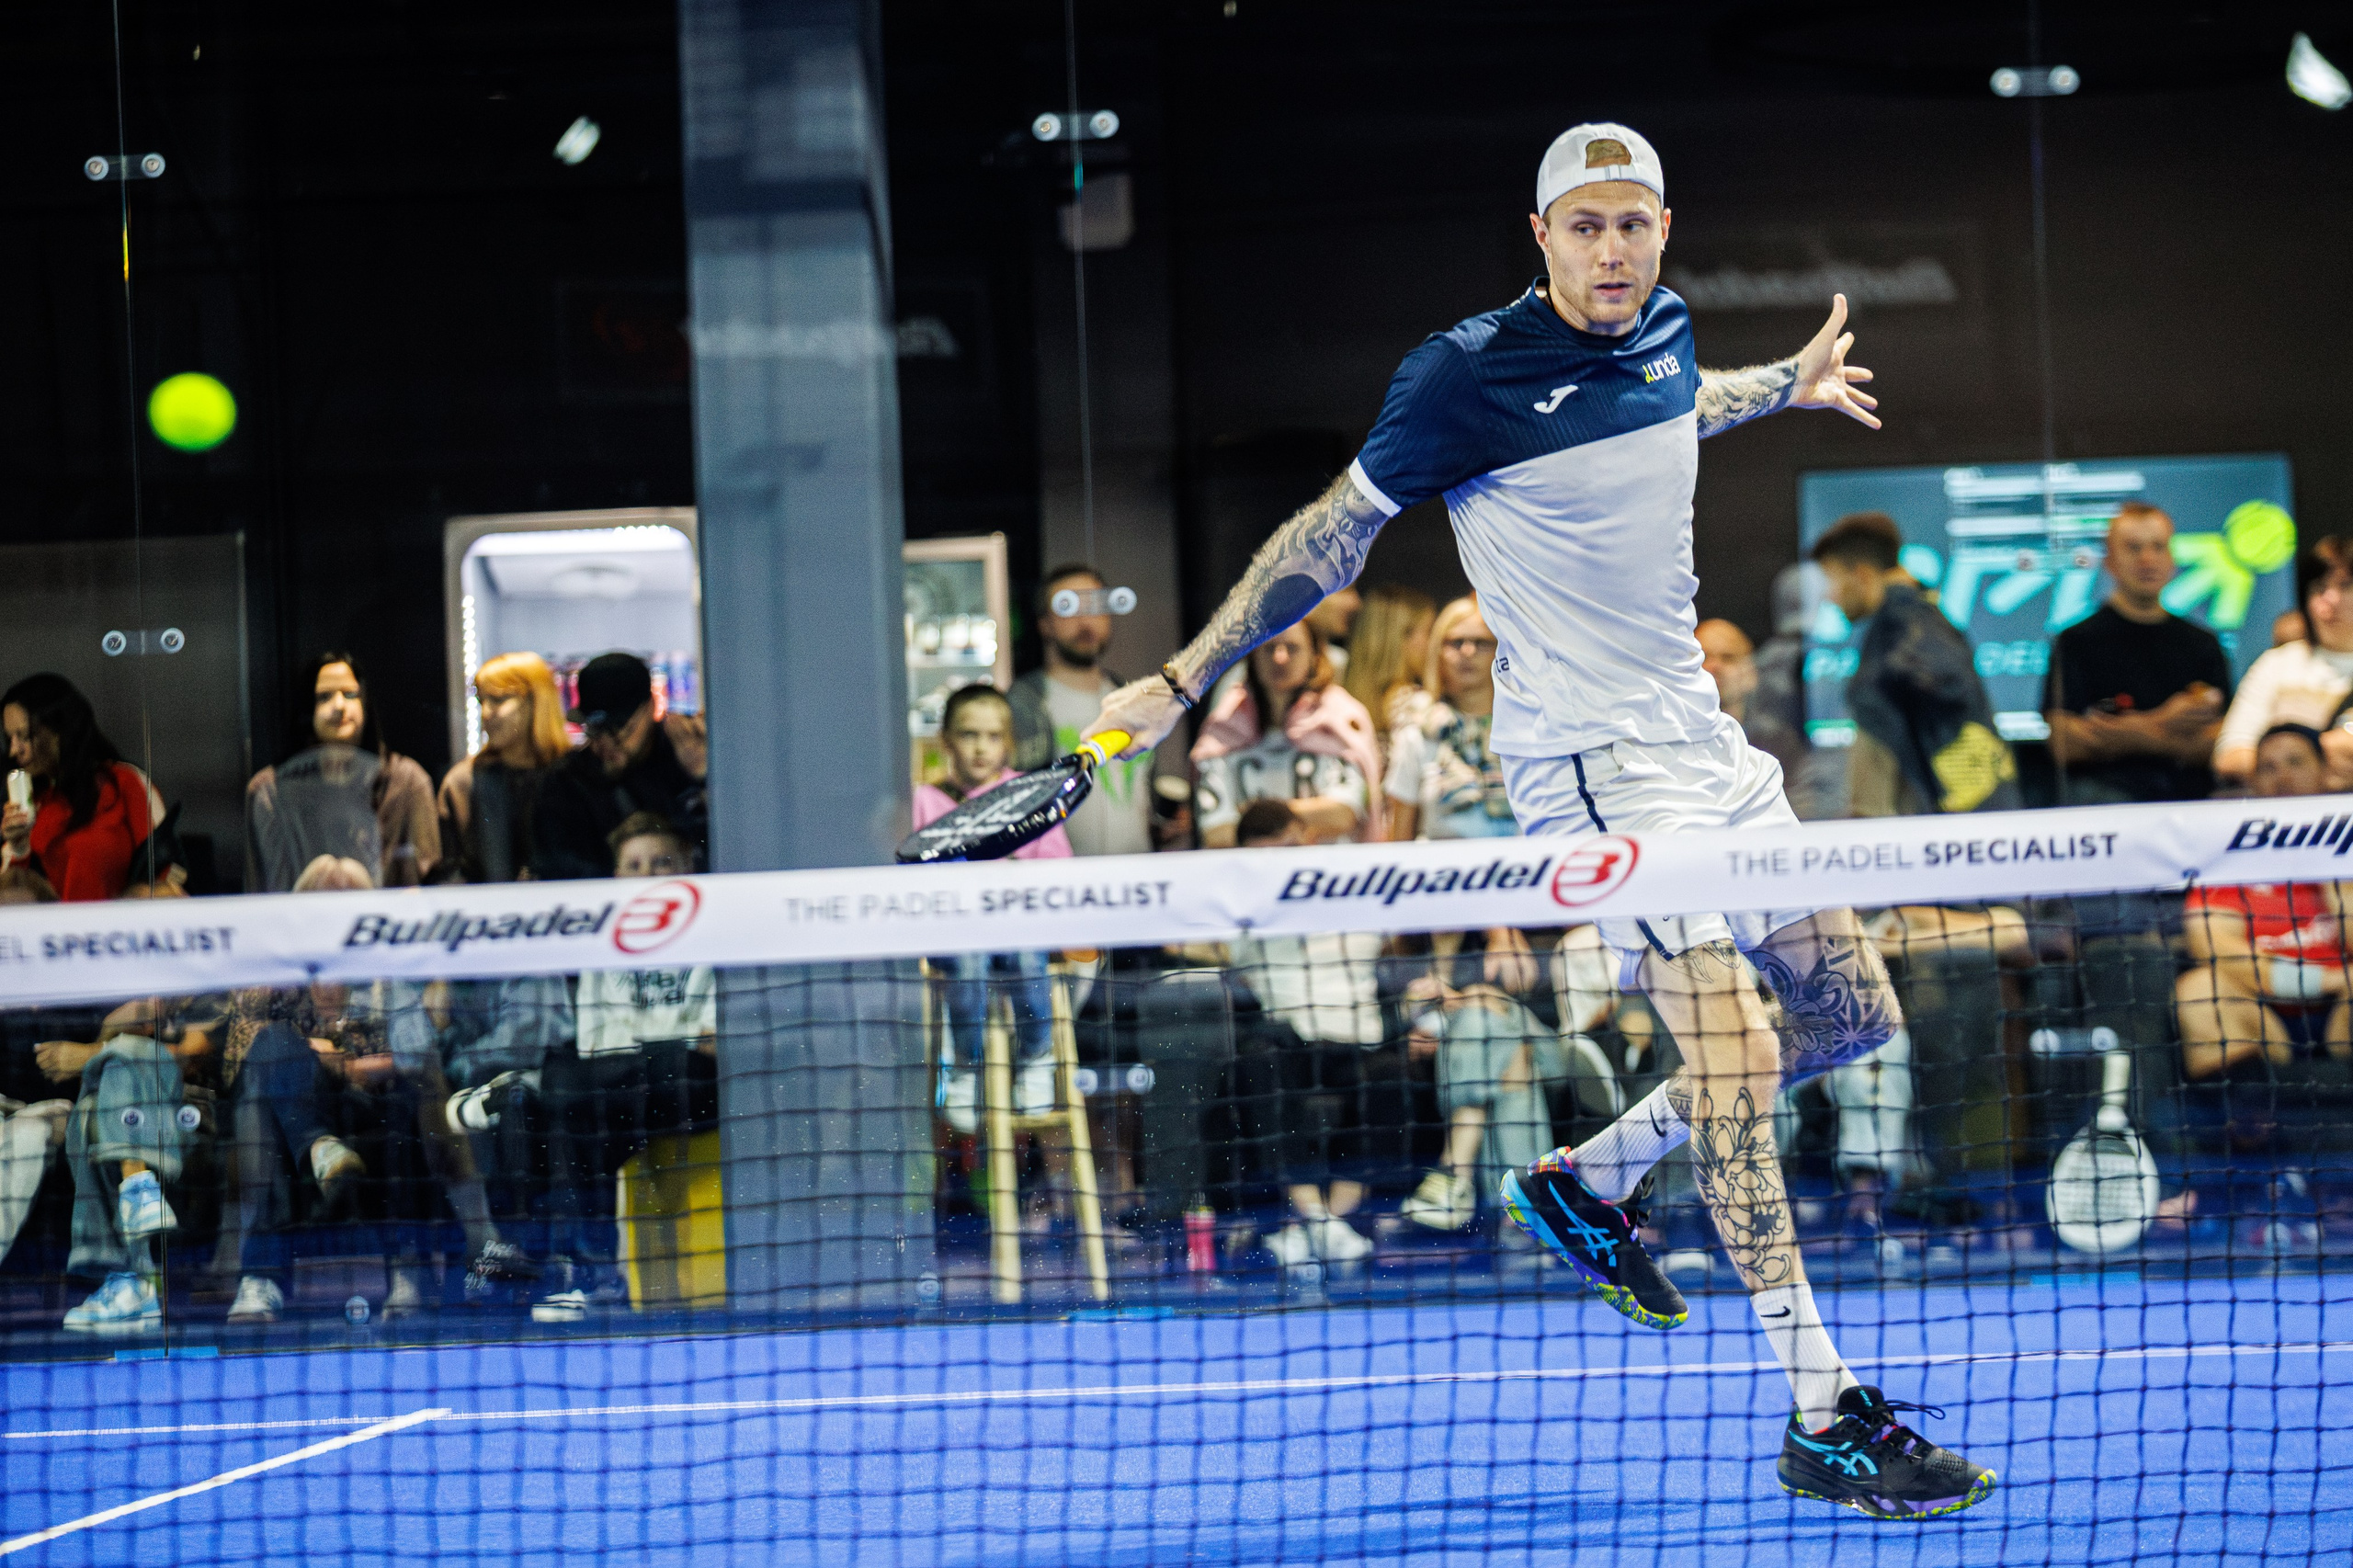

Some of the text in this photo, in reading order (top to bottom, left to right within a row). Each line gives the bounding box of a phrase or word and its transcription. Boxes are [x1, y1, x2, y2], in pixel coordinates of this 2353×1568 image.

[1642, 351, 1681, 384] Lunda
[1727, 833, 2118, 877] THE PADEL SPECIALIST
[1278, 855, 1553, 905] Bullpadel
[784, 881, 1170, 924] THE PADEL SPECIALIST
[42, 927, 233, 959] SPECIALIST
[343, 902, 615, 953] Bullpadel
